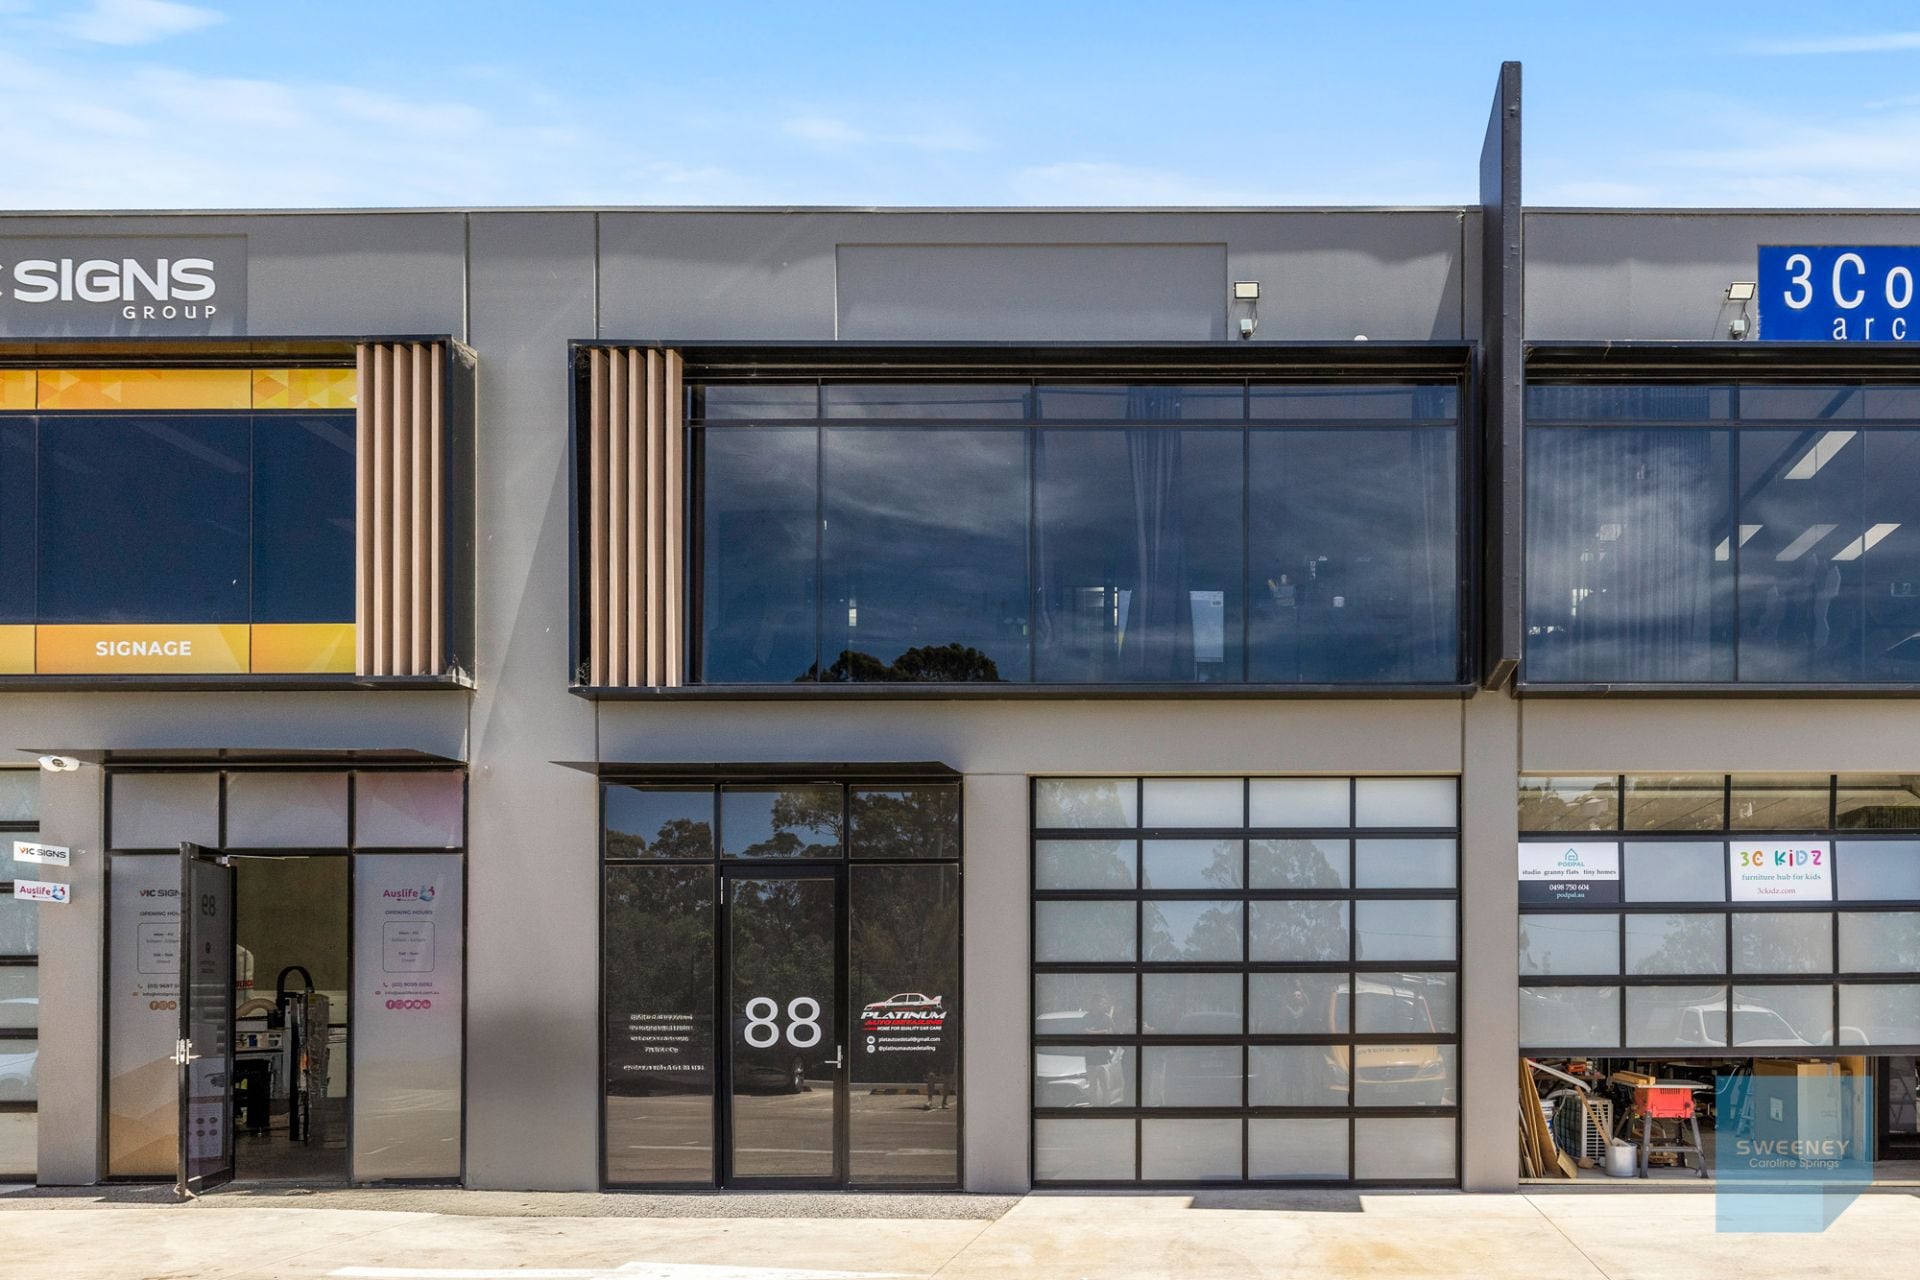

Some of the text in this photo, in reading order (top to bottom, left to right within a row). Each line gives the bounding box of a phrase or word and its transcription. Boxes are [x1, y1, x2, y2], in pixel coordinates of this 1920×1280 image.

[13, 258, 216, 302] SIGNS
[122, 305, 217, 319] GROUP
[95, 640, 192, 656] SIGNAGE
[19, 847, 67, 859] VIC SIGNS
[1740, 850, 1764, 867] 3C
[1742, 873, 1775, 881] furniture
[1776, 873, 1791, 881] hub
[20, 886, 51, 896] Auslife
[1549, 883, 1589, 891] 0498 750 604
[1757, 887, 1796, 895] 3ckidz.com
[139, 889, 180, 897] VIC SIGN
[383, 889, 418, 898] Auslife
[860, 1011, 947, 1019] PLATINUM
[744, 996, 822, 1048] 88
